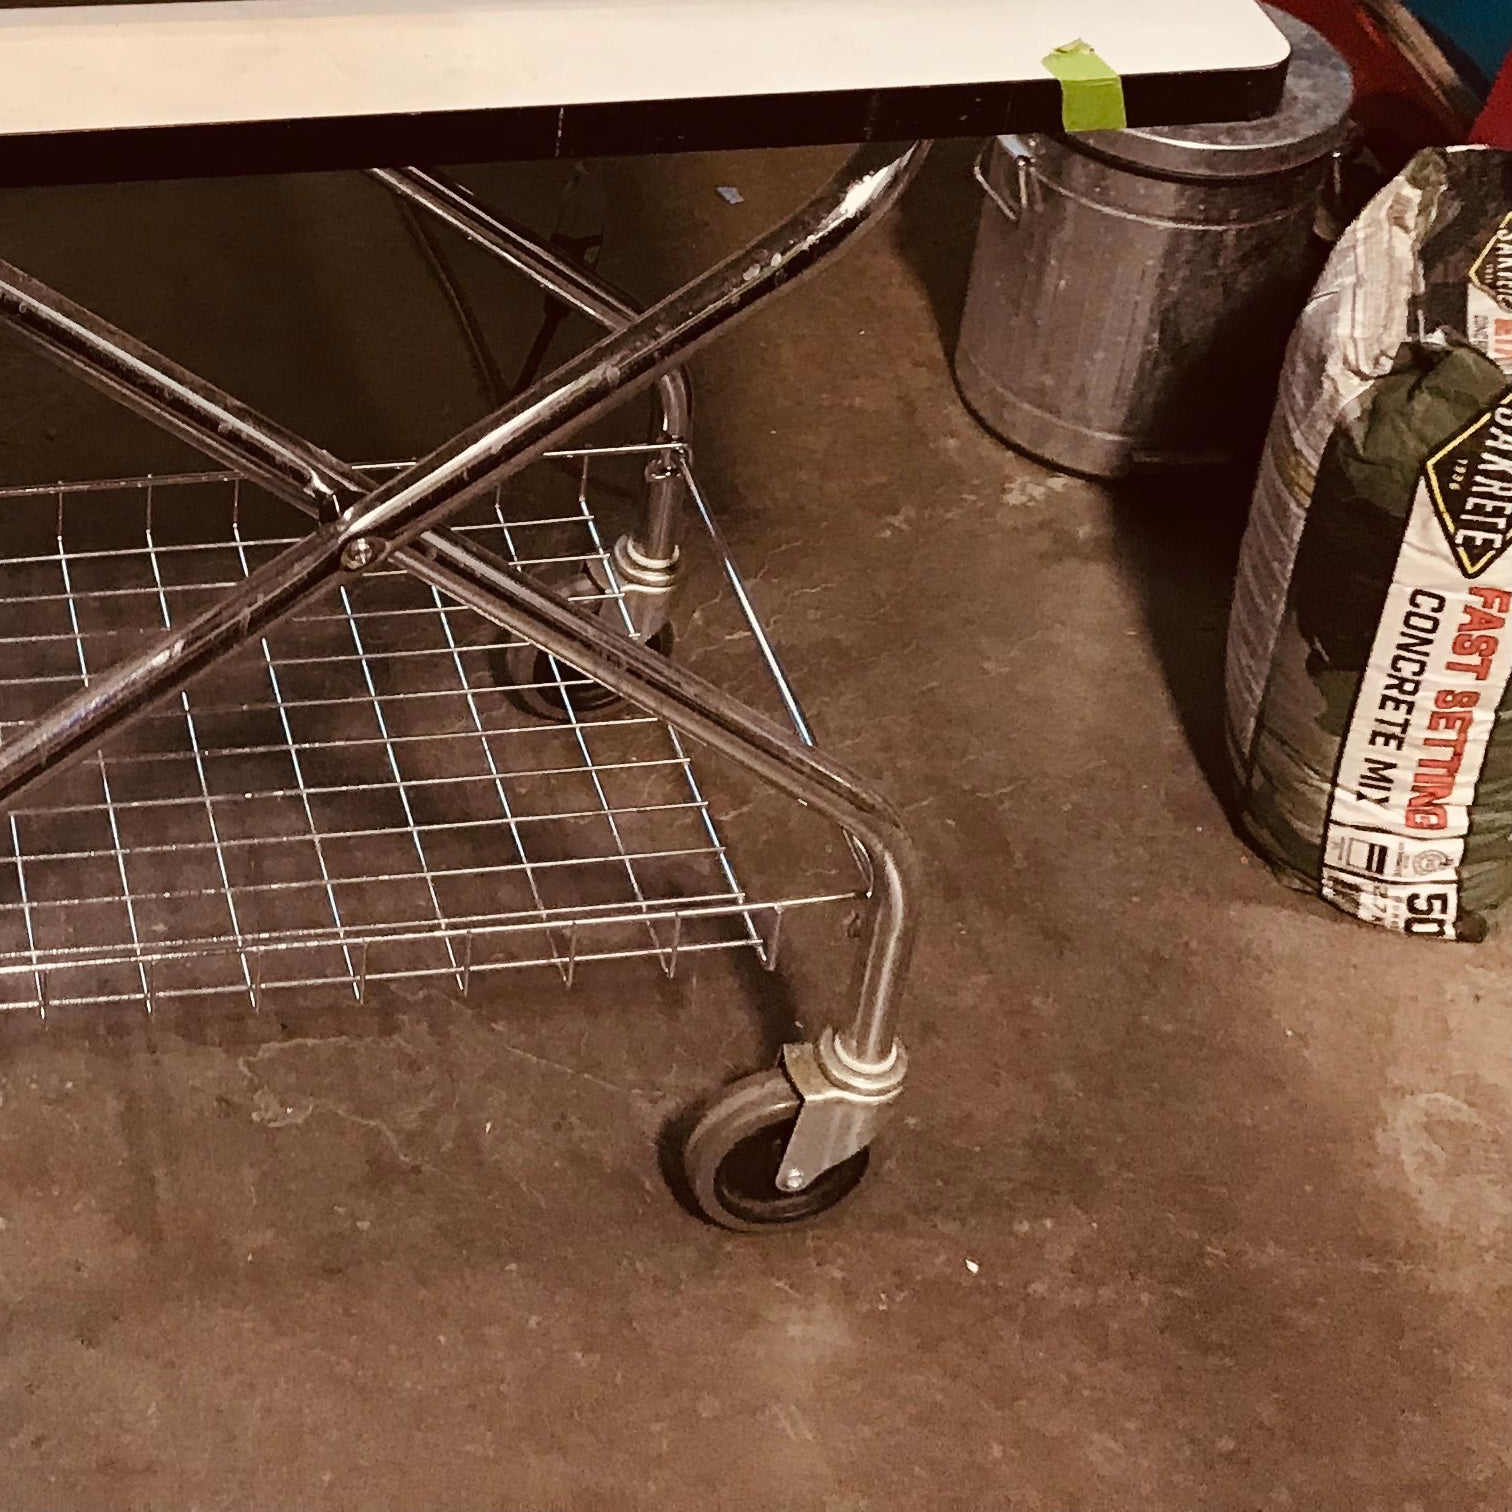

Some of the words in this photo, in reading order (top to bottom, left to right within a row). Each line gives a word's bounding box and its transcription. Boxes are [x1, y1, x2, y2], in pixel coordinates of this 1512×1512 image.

[1368, 589, 1446, 752] CONCRETE
[1446, 586, 1512, 682] FAST
[1356, 758, 1397, 810] MIX
[1405, 689, 1481, 830] SETTING
[1404, 892, 1449, 936] 50
